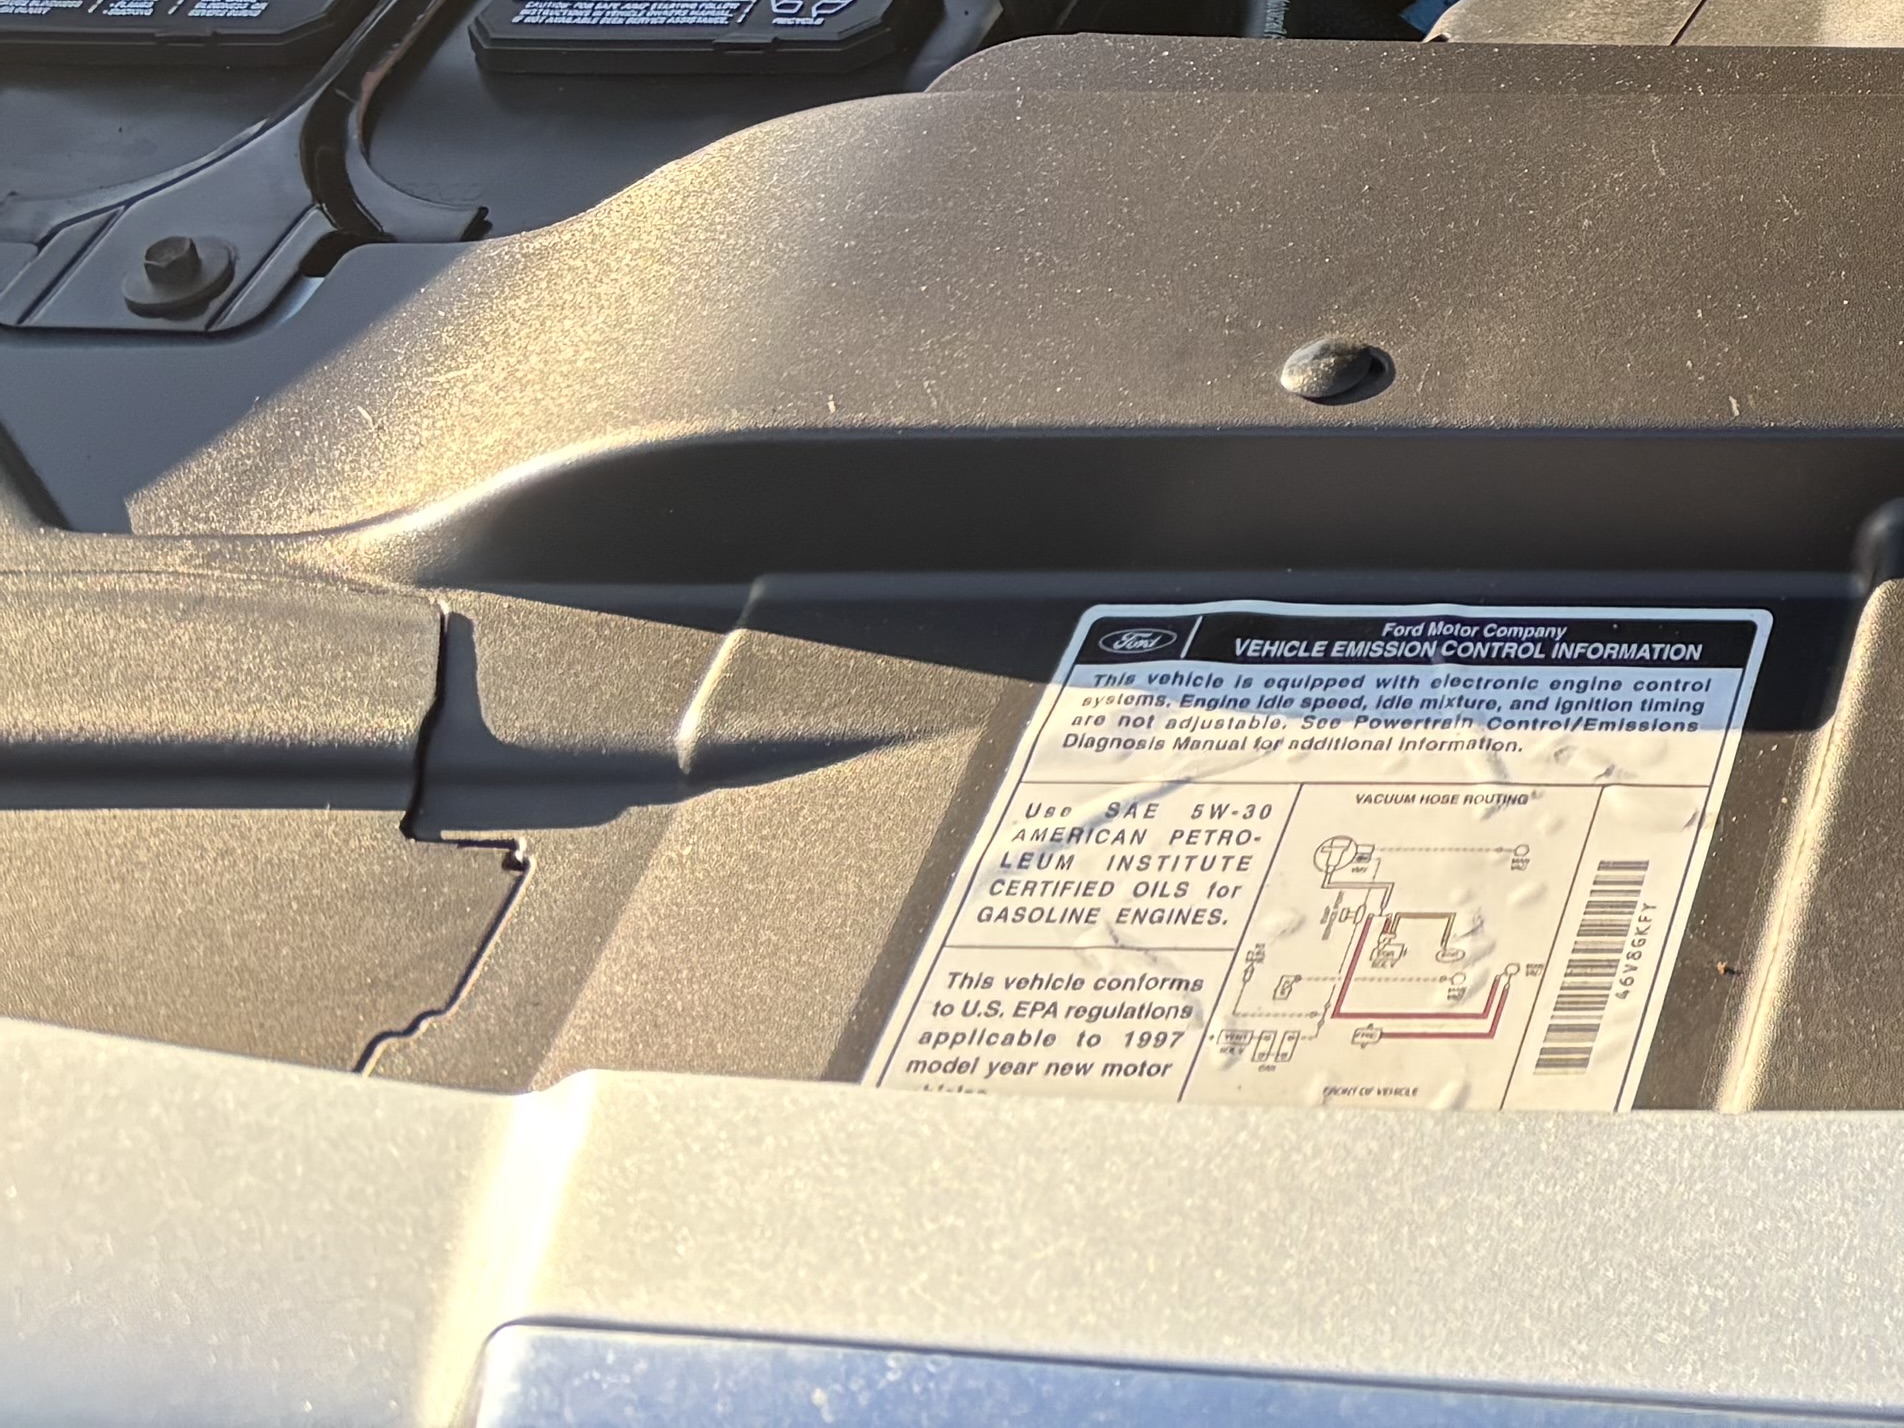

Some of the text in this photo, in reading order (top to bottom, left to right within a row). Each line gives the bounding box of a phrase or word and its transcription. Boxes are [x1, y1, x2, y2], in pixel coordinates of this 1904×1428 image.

[1112, 622, 1568, 650] Ford Ford Motor Company
[1234, 638, 1703, 662] VEHICLE EMISSION CONTROL INFORMATION
[1093, 670, 1712, 695] This vehicle is equipped with electronic engine control
[1081, 693, 1706, 717] systems. Engine idle speed, idle mixture, and ignition timing
[1070, 712, 1700, 733] are not adjustable. See Powertrain Control/Emissions
[1061, 733, 1523, 754] Diagnosis Manual for additional information.
[1025, 801, 1273, 821] Use SAE 5W-30
[1355, 793, 1529, 807] VACUUM HOSE ROUTING
[1010, 826, 1262, 846] AMERICAN PETRO-
[999, 851, 1254, 872] LEUM INSTITUTE
[988, 878, 1243, 900] CERTIFIED OILS for
[976, 905, 1228, 927] GASOLINE ENGINES.
[1614, 901, 1658, 1001] 46V8GKFY
[946, 971, 1205, 993] This vehicle conforms
[931, 999, 1194, 1024] to U.S. EPA regulations
[917, 1028, 1186, 1050] applicable to 1997
[904, 1056, 1174, 1080] model year new motor
